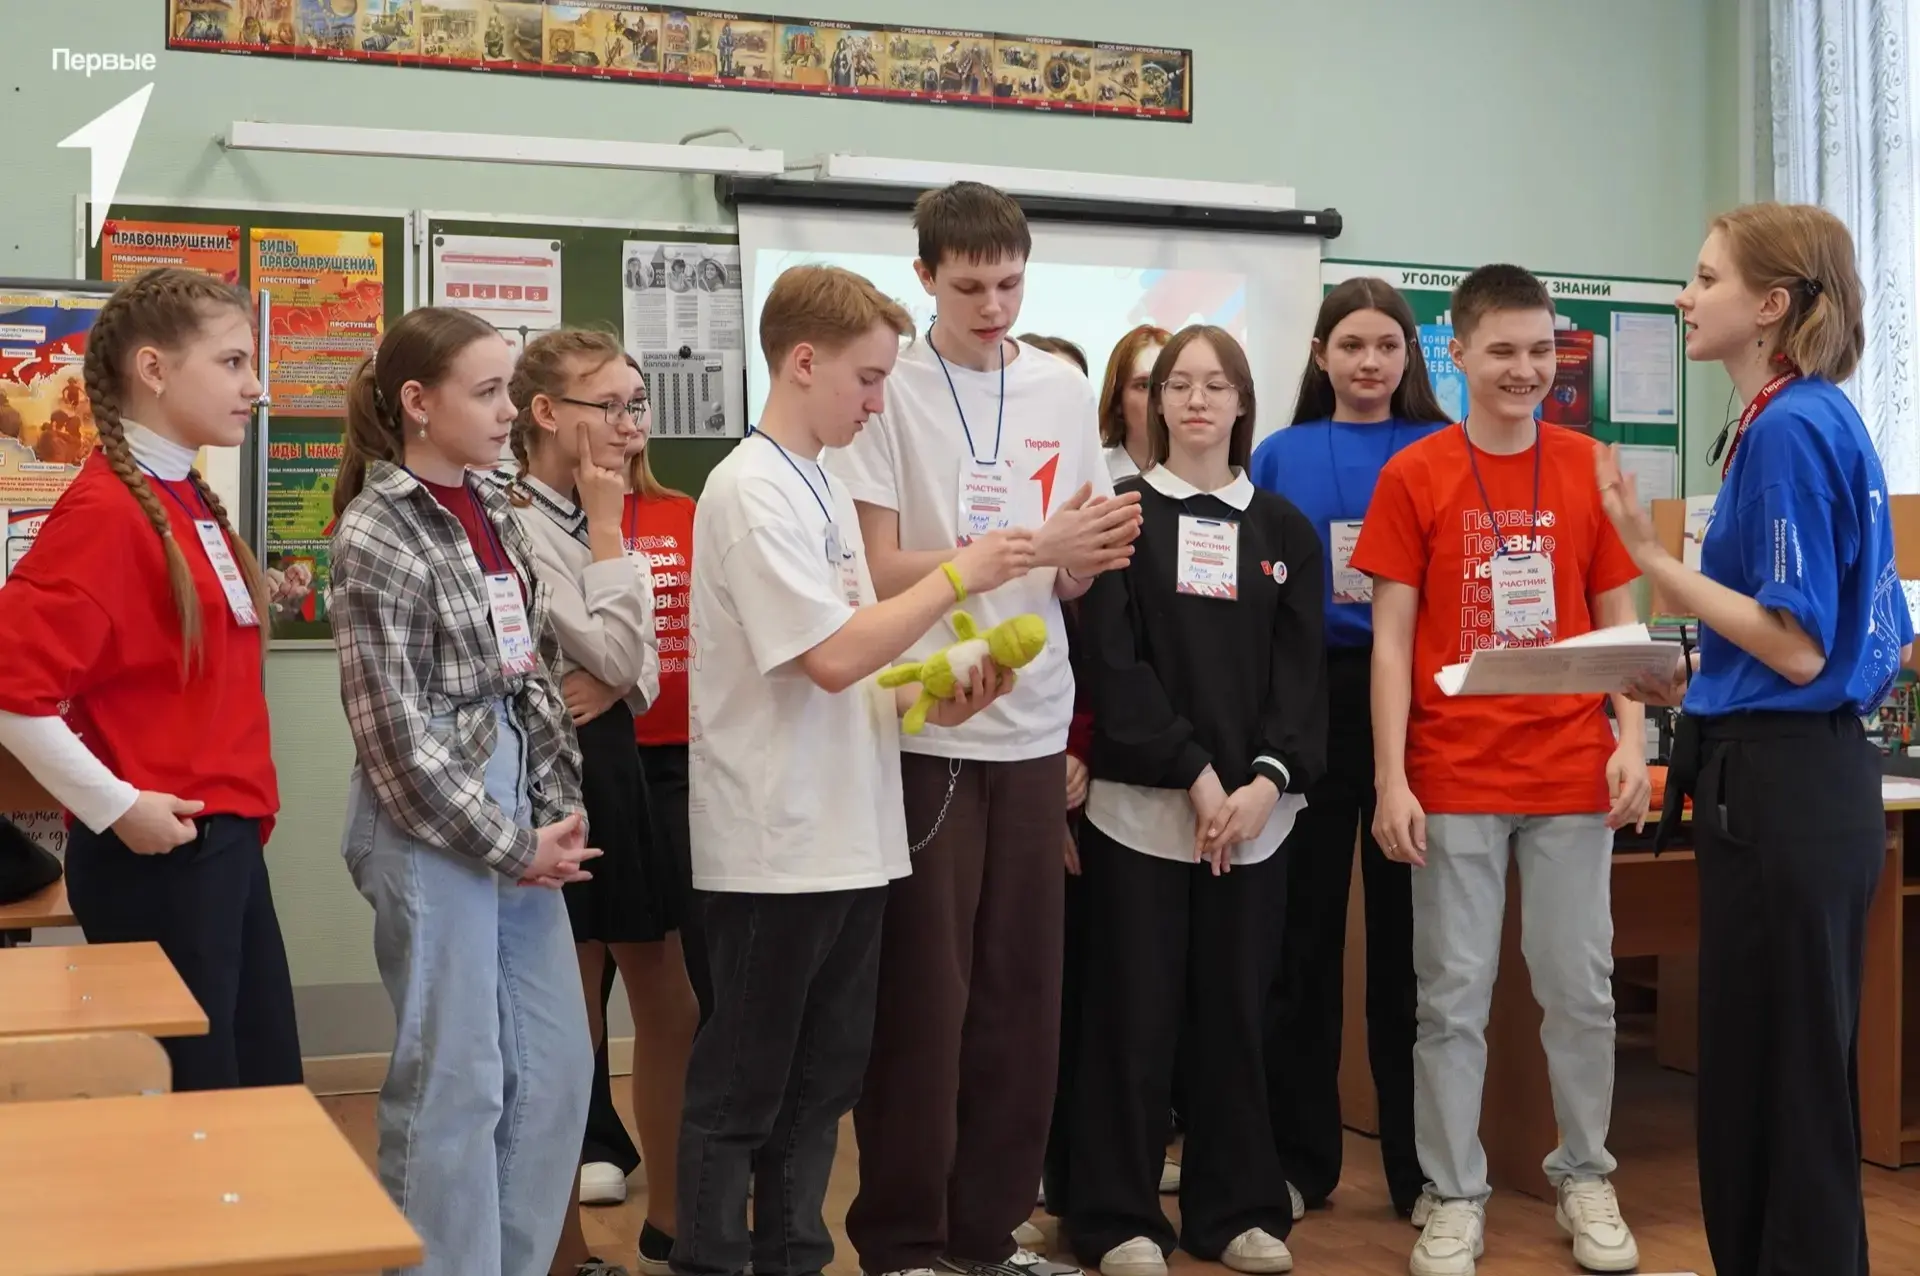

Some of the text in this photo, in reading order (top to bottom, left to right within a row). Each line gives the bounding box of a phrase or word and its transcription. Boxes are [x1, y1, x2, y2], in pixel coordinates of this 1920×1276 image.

[112, 232, 232, 249] ПРАВОНАРУШЕНИЕ
[260, 240, 296, 253] ВИДЫ
[260, 255, 375, 271] ПРАВОНАРУШЕНИЙ
[260, 276, 316, 285] ПРЕСТУПЛЕНИЕ
[1402, 271, 1460, 287] УГОЛОК
[1552, 281, 1611, 296] ЗНАНИЙ
[454, 289, 540, 300] 5 4 3 2
[329, 321, 375, 329] ПРОСТУПКИ:
[1762, 372, 1796, 397] Первые
[1738, 403, 1758, 435] Первые
[268, 443, 301, 459] ИДЫ
[1024, 438, 1060, 451] Первые
[966, 484, 1008, 494] УЧАСТНИК
[1463, 509, 1556, 533] Первые
[1185, 539, 1231, 552] УЧАСТНИК
[1499, 578, 1547, 589] УЧАСТНИК
